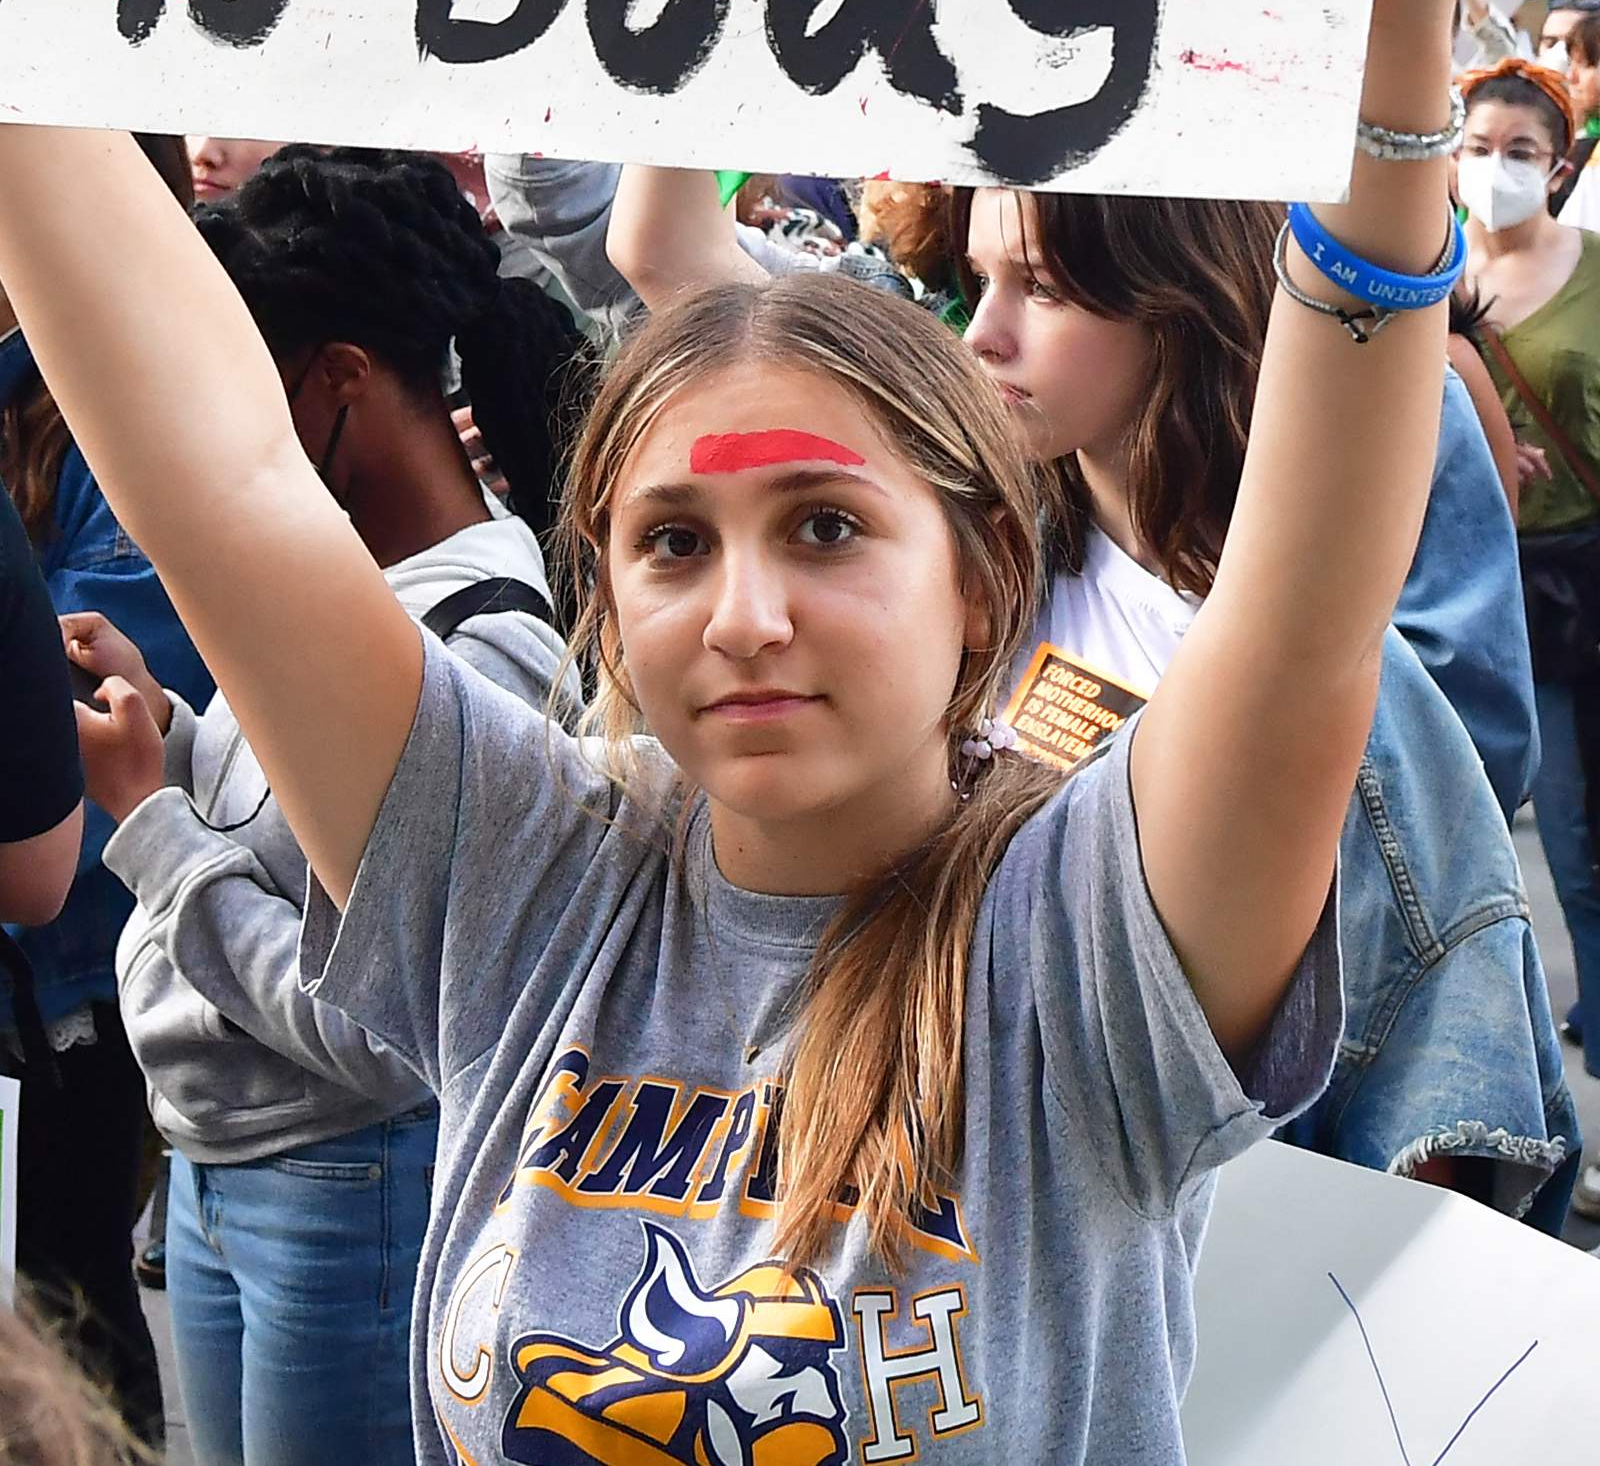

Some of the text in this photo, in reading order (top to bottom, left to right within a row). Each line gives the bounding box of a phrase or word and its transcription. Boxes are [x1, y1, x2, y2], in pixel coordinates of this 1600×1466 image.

[1330, 262, 1358, 284] AM
[1042, 663, 1102, 699] FORCED
[1024, 698, 1100, 741] IS FEMALE
